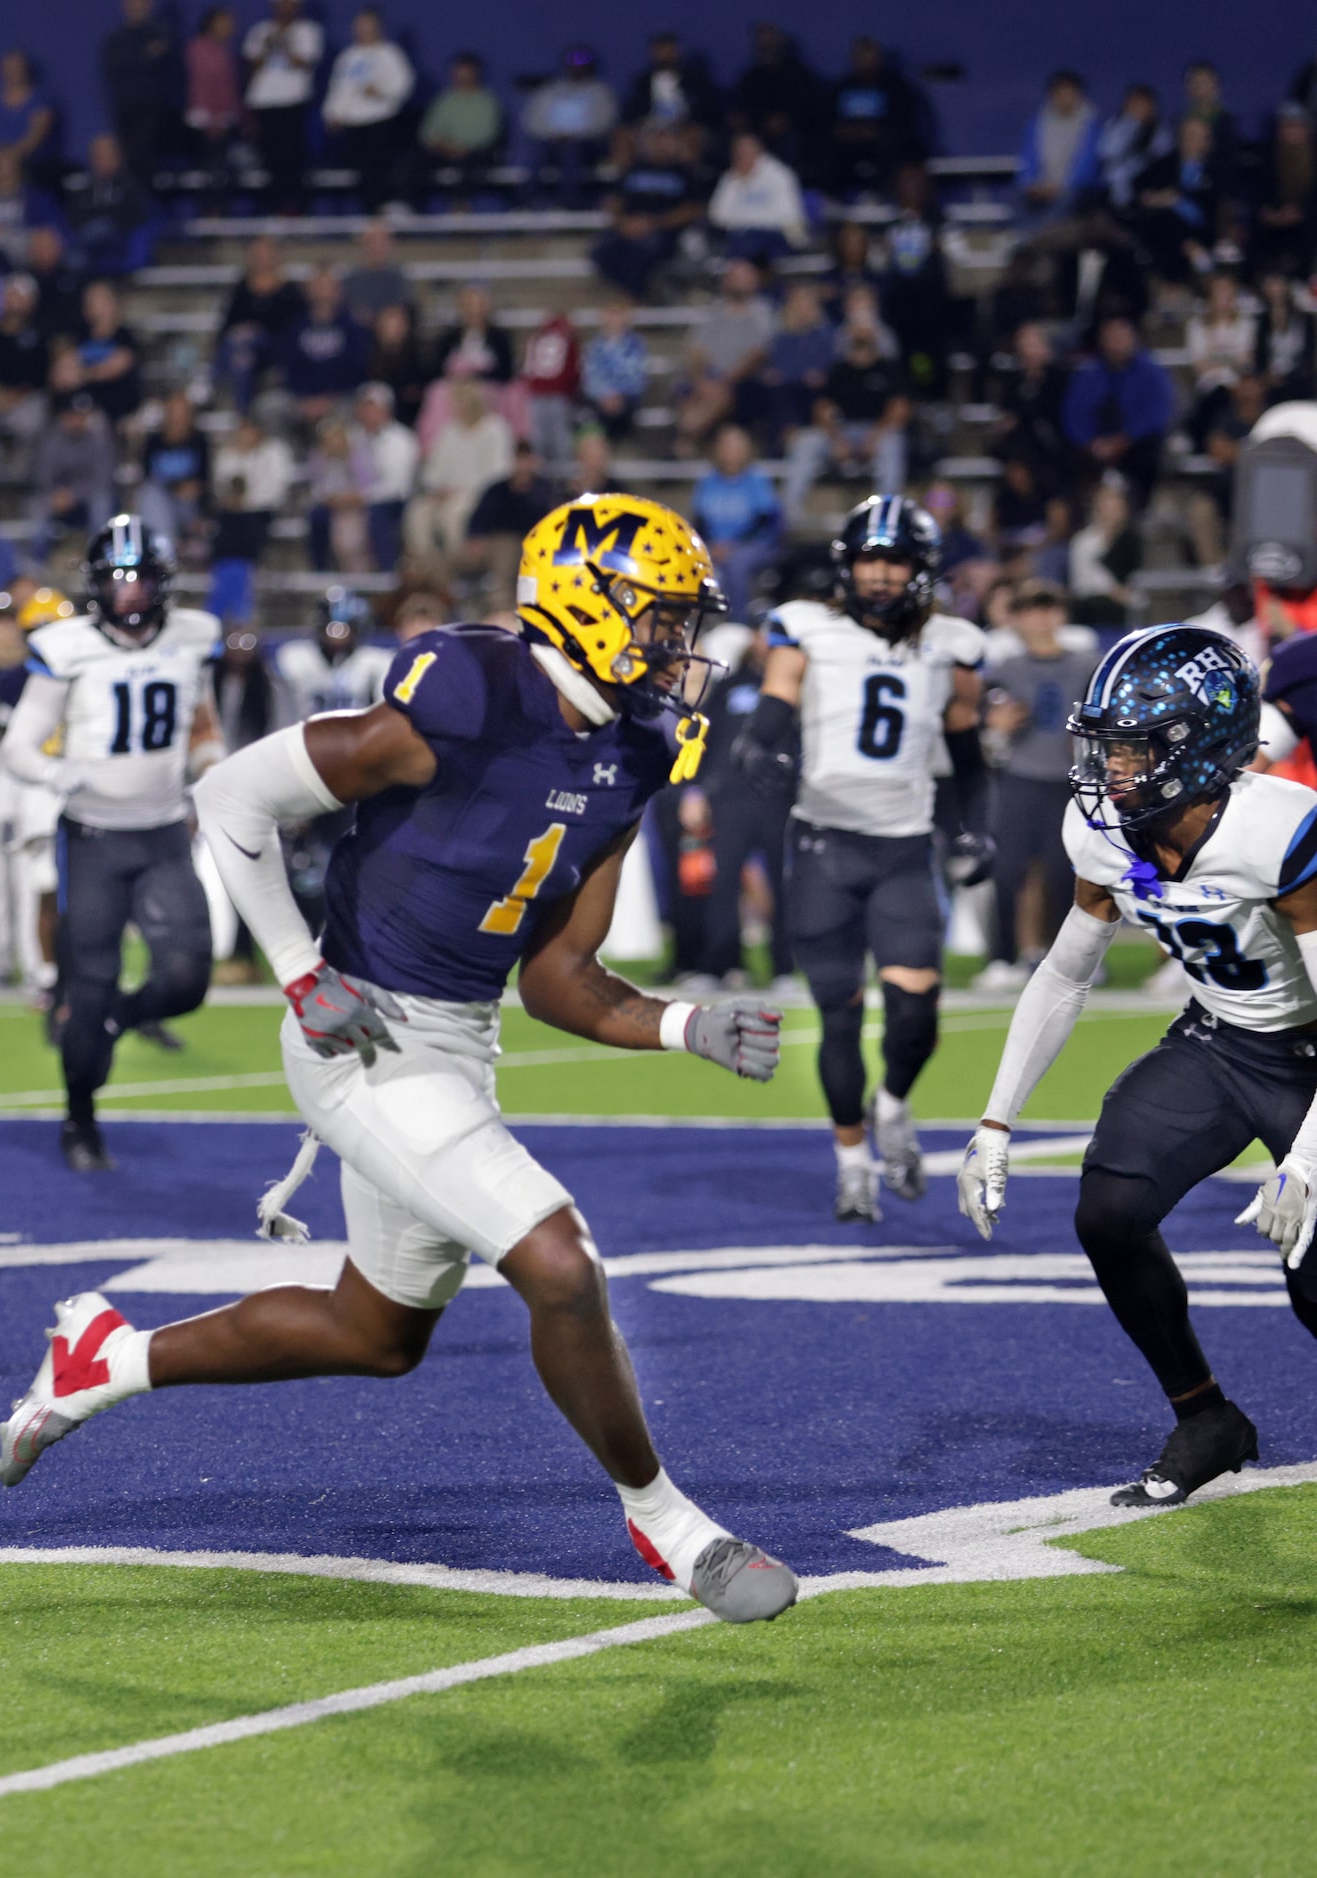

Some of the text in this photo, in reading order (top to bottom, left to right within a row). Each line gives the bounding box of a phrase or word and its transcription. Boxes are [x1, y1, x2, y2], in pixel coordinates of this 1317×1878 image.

[552, 508, 650, 576] M
[393, 651, 438, 705] 1
[1174, 646, 1230, 696] RH
[110, 681, 176, 755] 18
[857, 672, 907, 761] 6
[545, 789, 588, 815] LIONS
[477, 822, 567, 934] 1
